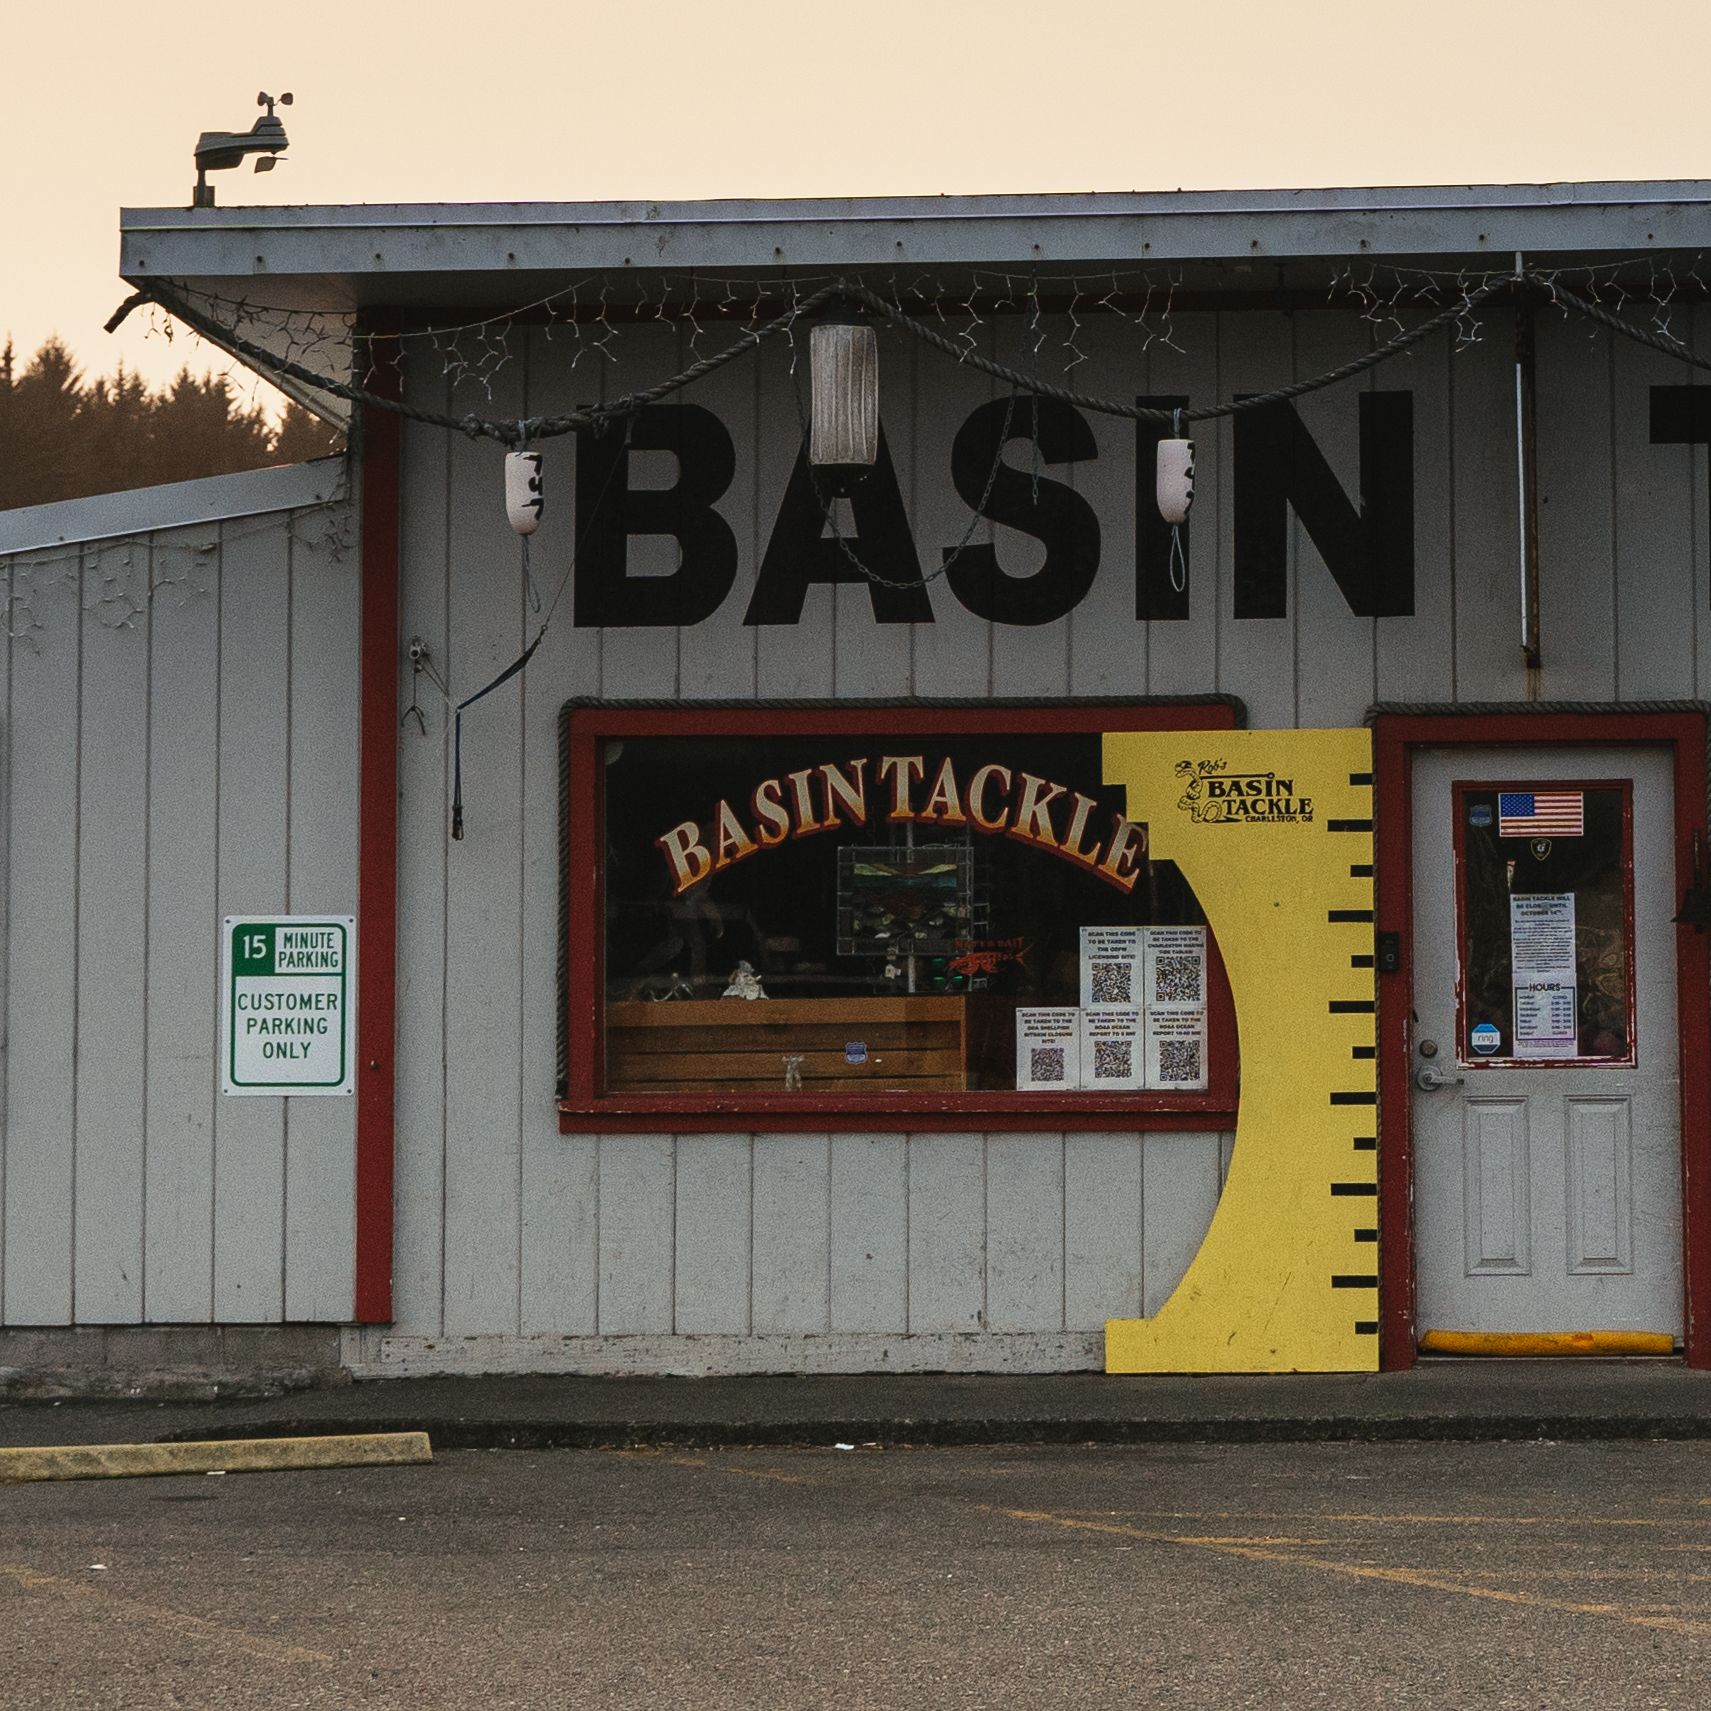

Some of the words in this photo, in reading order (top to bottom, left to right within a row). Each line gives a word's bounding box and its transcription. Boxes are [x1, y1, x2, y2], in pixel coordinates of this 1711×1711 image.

[572, 390, 1415, 628] BASIN
[1198, 758, 1228, 775] Rob's
[1208, 779, 1294, 798] BASIN
[1222, 798, 1314, 815] TACKLE
[656, 758, 868, 895] BASIN
[877, 755, 1148, 894] TACKLE
[243, 935, 267, 959] 15
[283, 932, 335, 949] MINUTE
[279, 952, 339, 968] PARKING
[1529, 983, 1561, 992] HOURS
[238, 993, 338, 1011] CUSTOMER
[246, 1018, 328, 1035] PARKING
[1478, 1034, 1494, 1043] ring
[263, 1041, 311, 1059] ONLY
